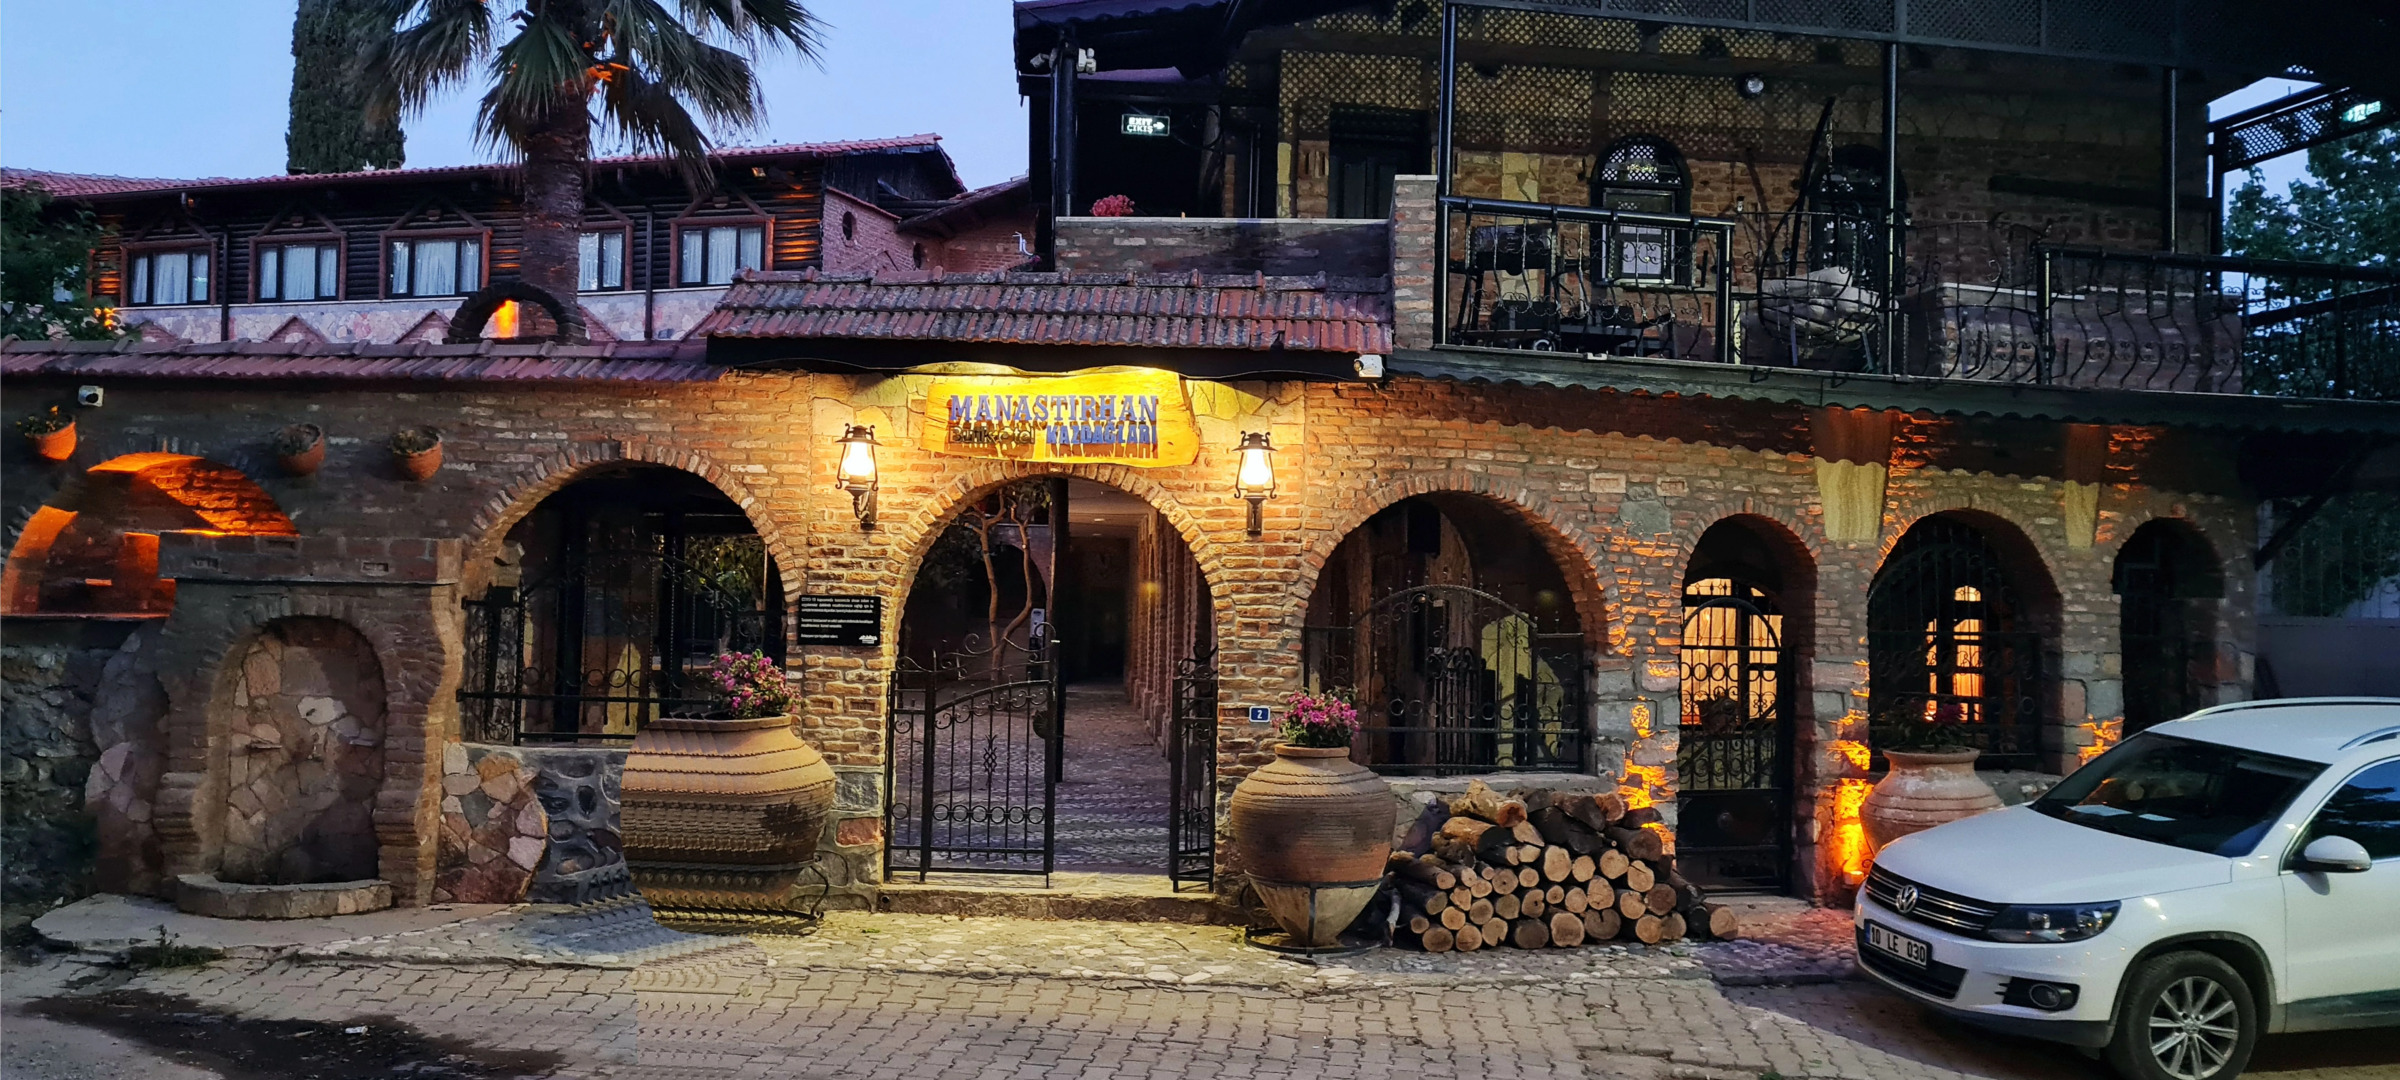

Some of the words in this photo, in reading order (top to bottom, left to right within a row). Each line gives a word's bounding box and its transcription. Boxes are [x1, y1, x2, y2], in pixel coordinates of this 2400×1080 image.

[1128, 117, 1153, 125] EXIT
[950, 394, 1158, 422] MANASTIRHAN
[1257, 709, 1263, 719] 2
[1871, 926, 1881, 944] 10
[1888, 933, 1899, 952] LE
[1907, 941, 1926, 962] 030
